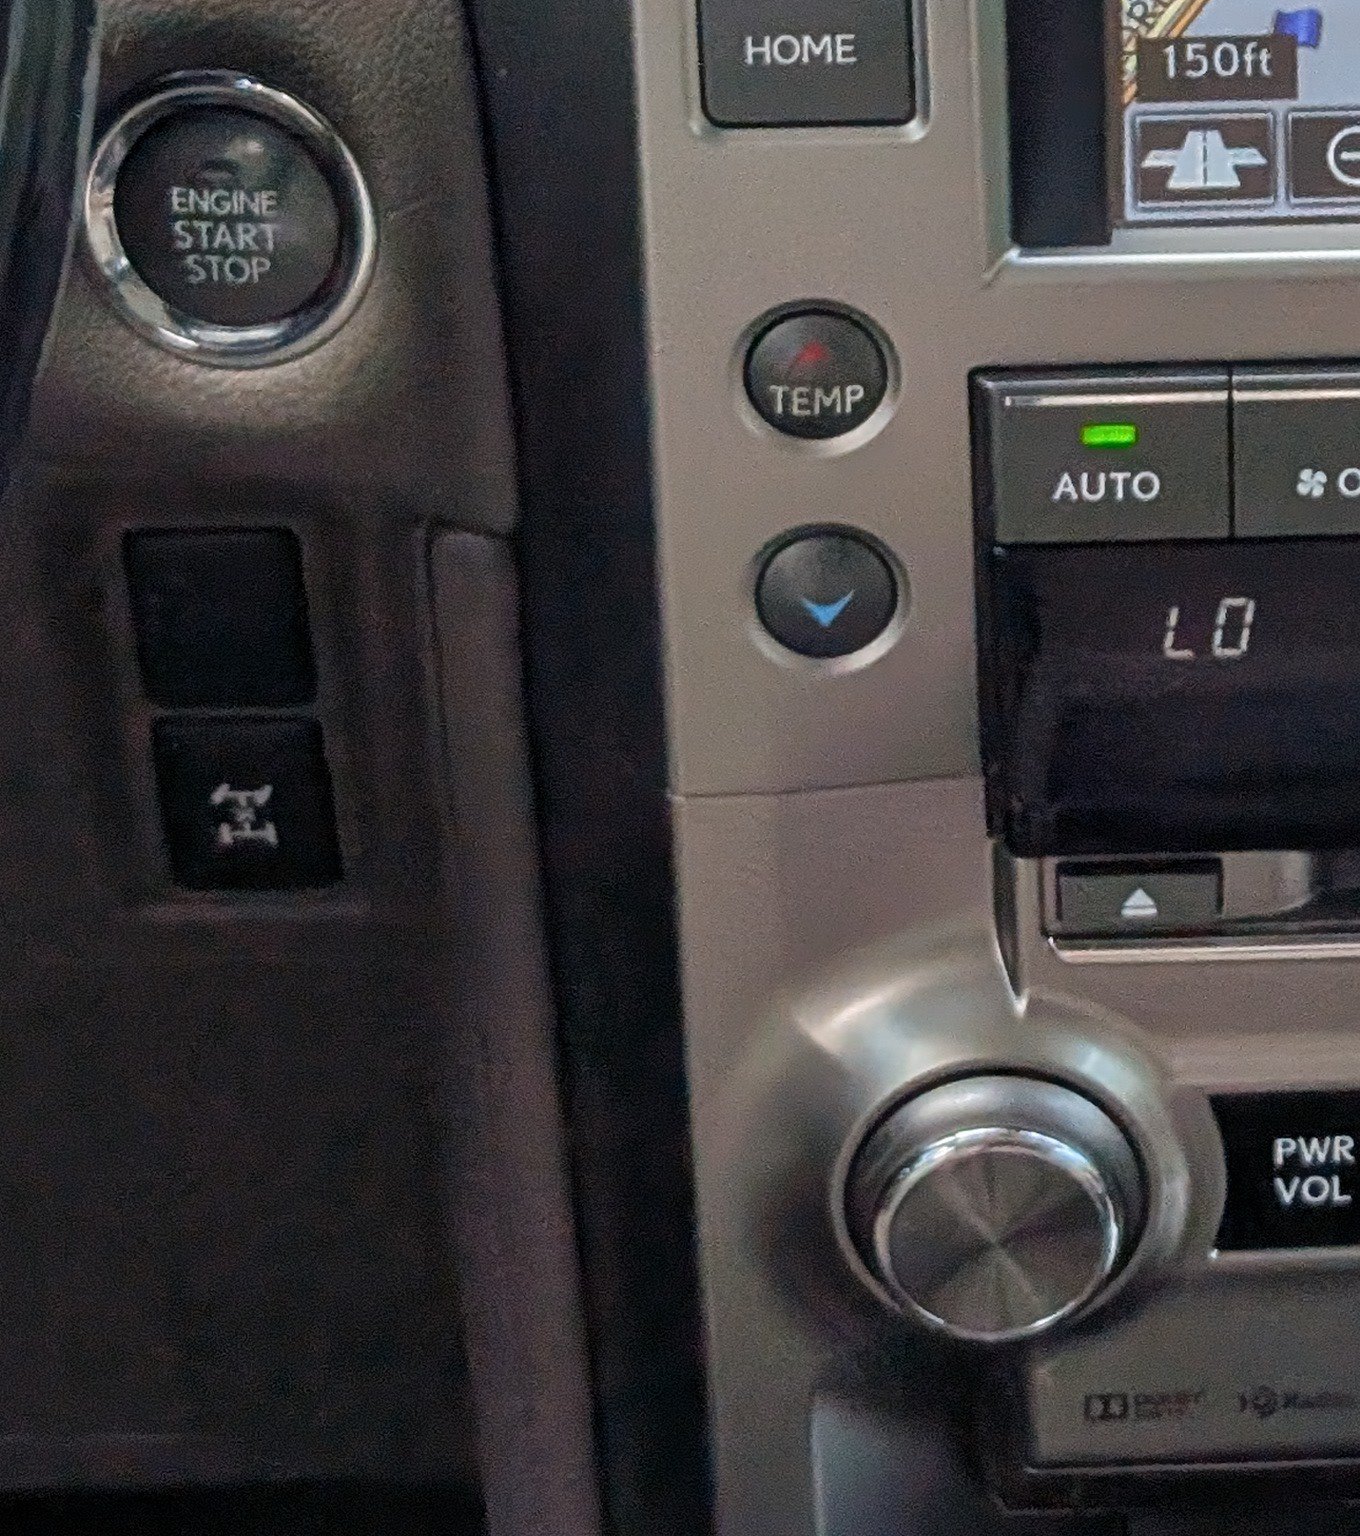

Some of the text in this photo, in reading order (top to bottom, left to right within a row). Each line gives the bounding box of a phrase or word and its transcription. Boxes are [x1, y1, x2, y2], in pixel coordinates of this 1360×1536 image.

[745, 33, 857, 65] HOME
[1163, 41, 1271, 79] 150ft
[171, 186, 278, 217] ENGINE
[173, 220, 275, 252] START
[184, 254, 272, 284] STOP
[769, 384, 865, 416] TEMP
[1052, 471, 1160, 501] AUTO
[1274, 1135, 1355, 1166] PWR
[1274, 1175, 1352, 1205] VOL
